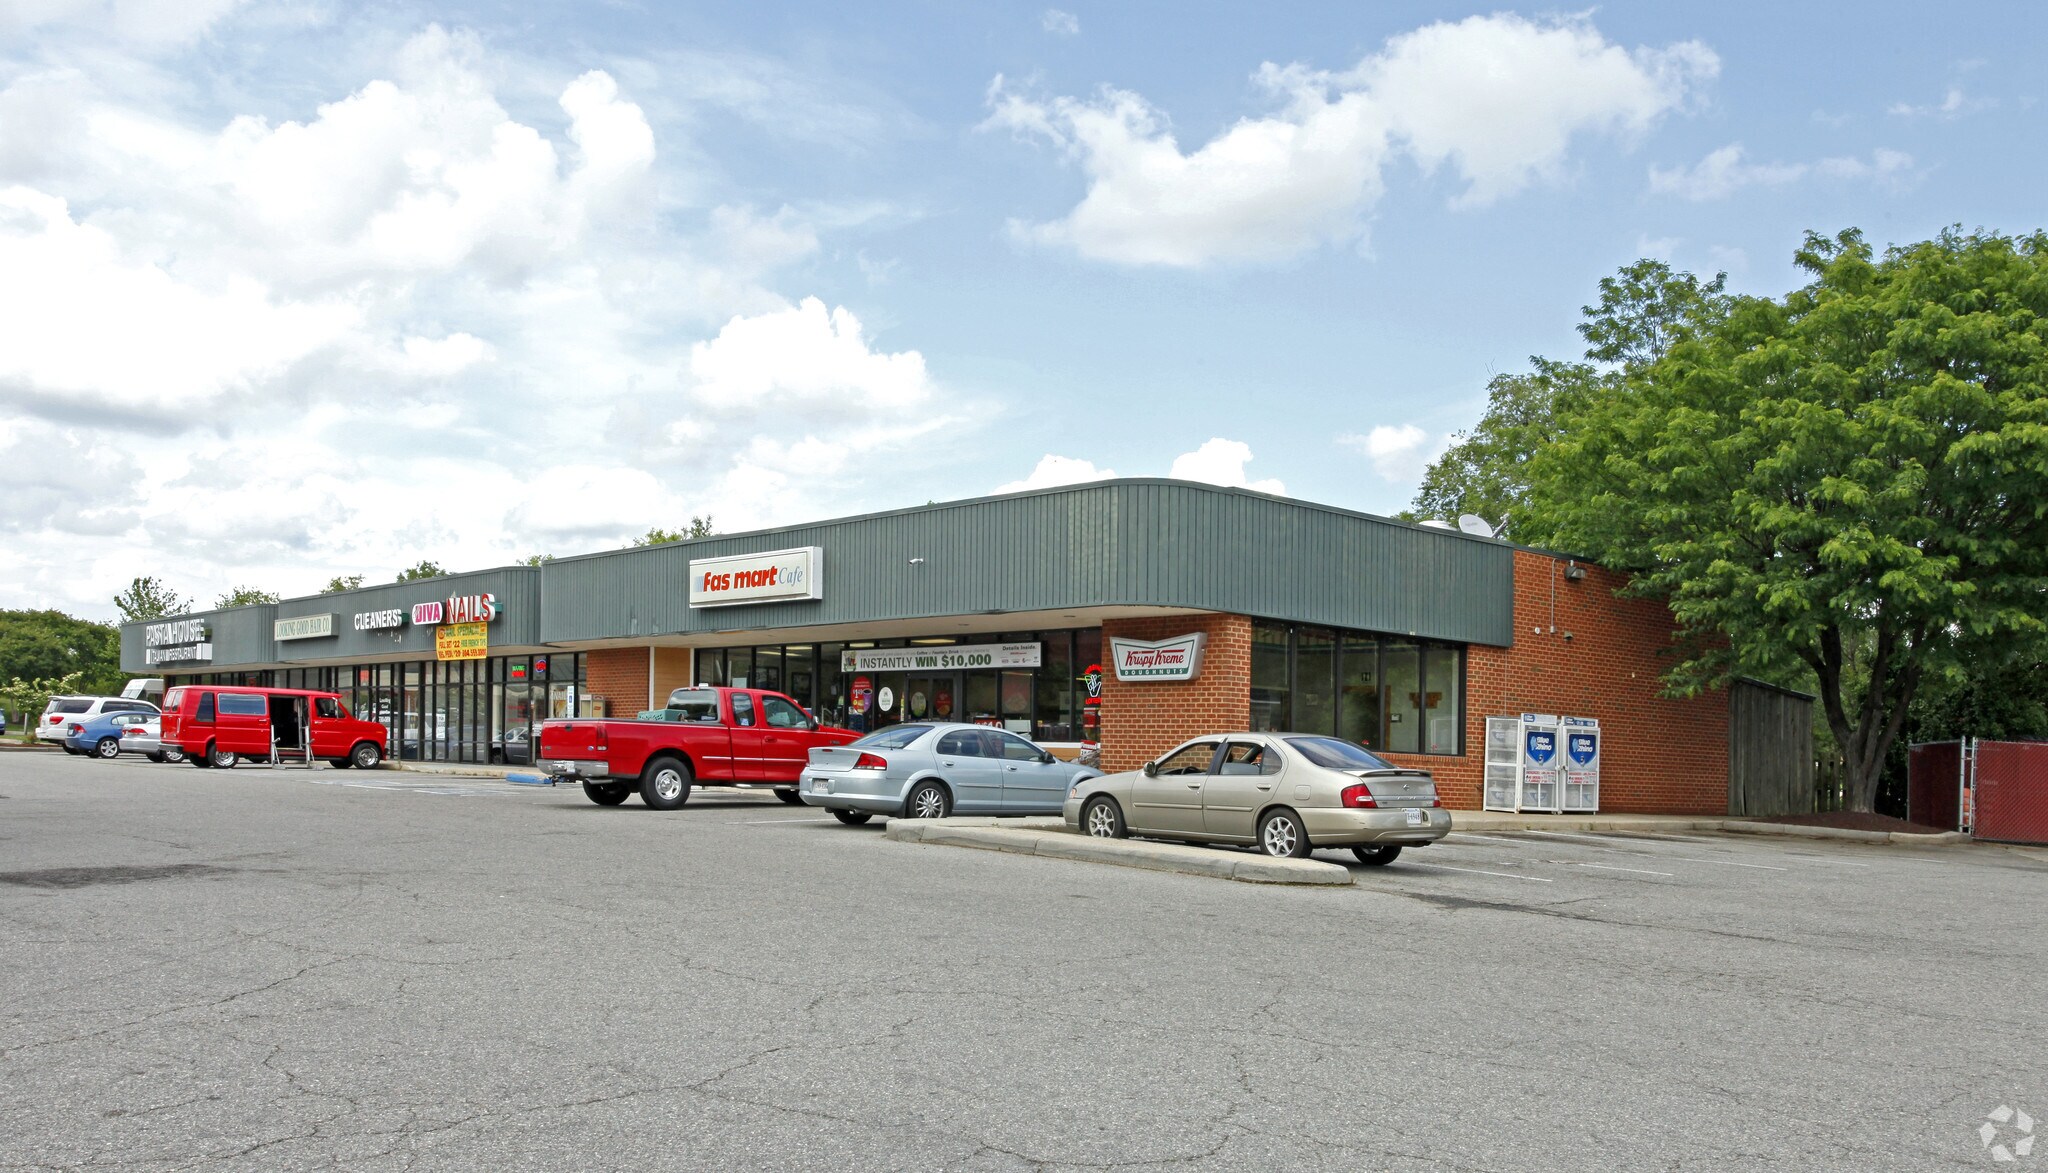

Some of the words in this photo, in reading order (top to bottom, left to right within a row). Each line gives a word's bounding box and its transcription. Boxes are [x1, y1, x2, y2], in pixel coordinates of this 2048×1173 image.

[703, 572, 730, 592] fas
[734, 566, 777, 588] mart
[779, 566, 803, 586] Cafe
[415, 603, 440, 622] DIVA
[446, 593, 495, 624] NAILS
[276, 621, 296, 638] LOOKING
[296, 619, 310, 636] GOOD
[310, 618, 323, 634] HAIR
[354, 609, 402, 630] CLEANERS
[146, 622, 171, 647] PASTA
[171, 618, 205, 645] HOUSE
[169, 646, 197, 662] RESTAURANT
[860, 656, 912, 669] INSTANTLY
[915, 656, 938, 668] WIN
[941, 653, 992, 668] $10,000
[1125, 650, 1155, 668] Krispy
[1154, 649, 1186, 666] Kreme
